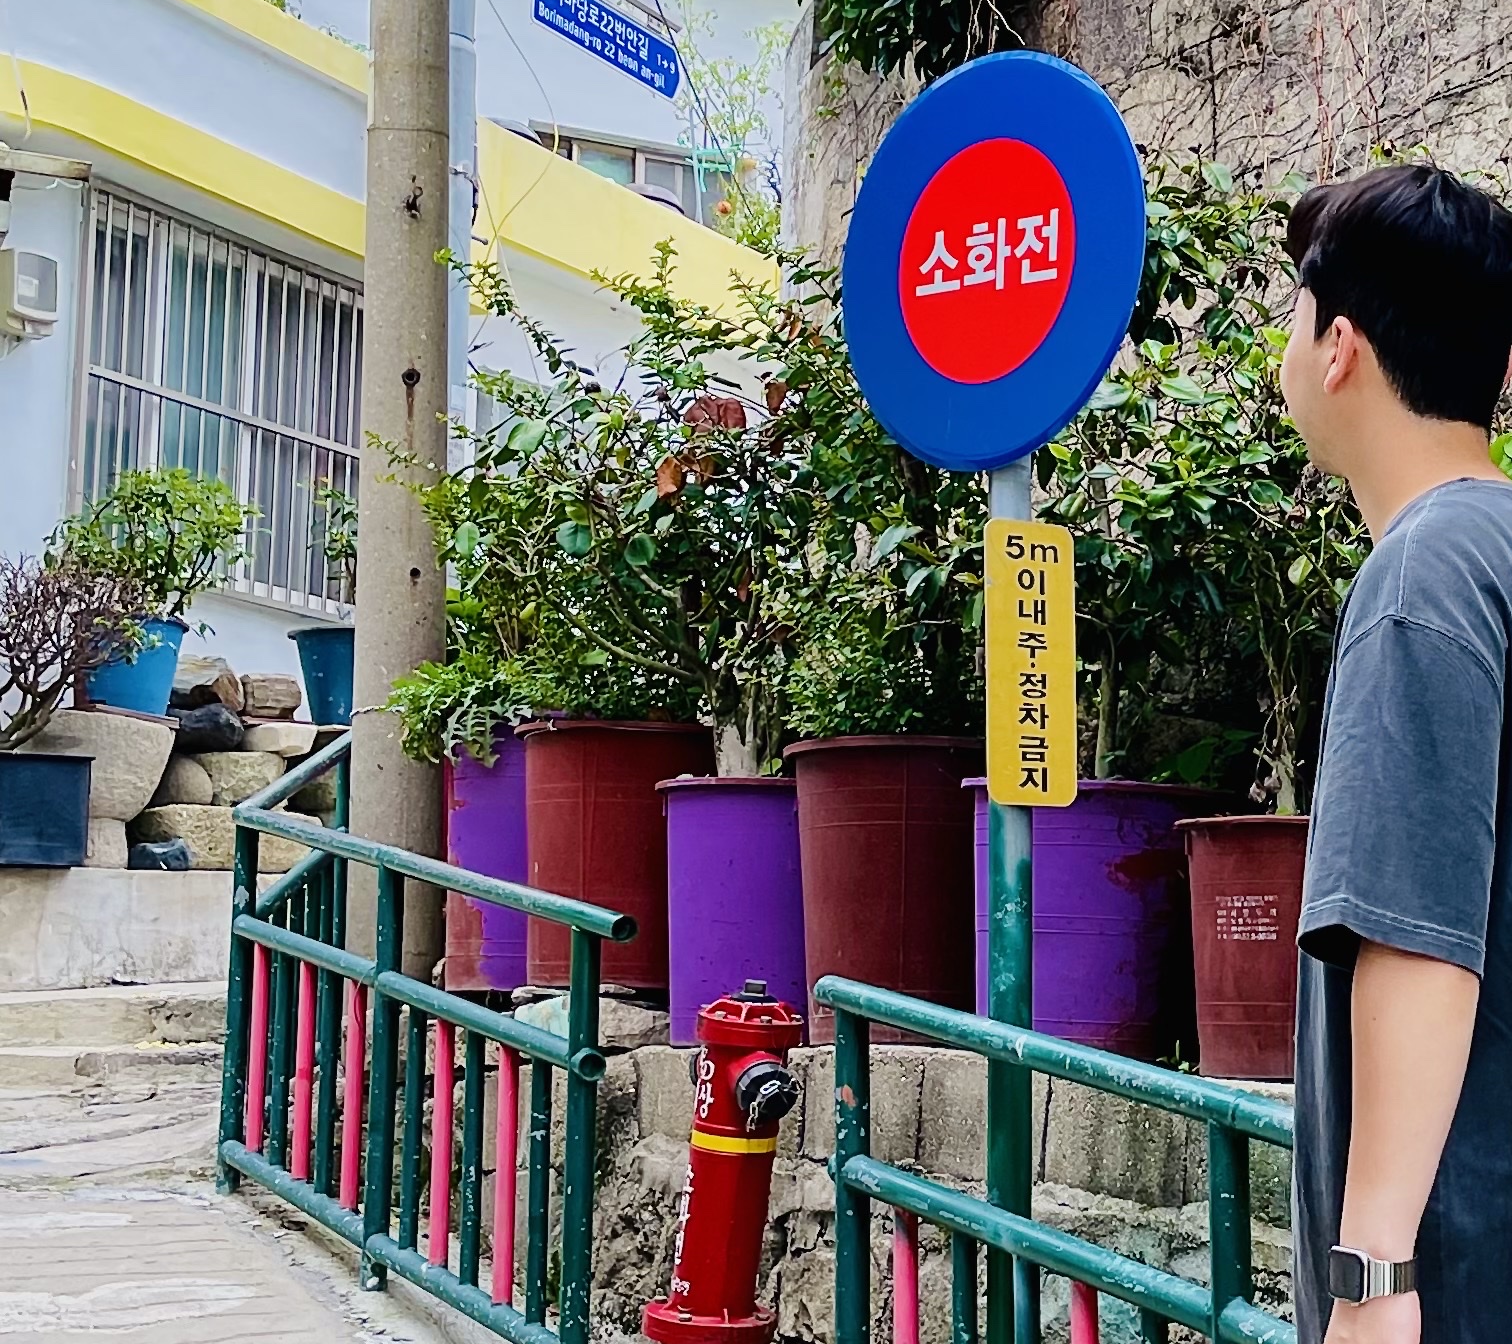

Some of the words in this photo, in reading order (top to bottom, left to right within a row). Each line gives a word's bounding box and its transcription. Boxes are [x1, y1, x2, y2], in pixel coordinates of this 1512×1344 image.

[537, 0, 602, 52] Borimadang-ro
[604, 40, 615, 60] 22
[617, 48, 639, 73] beon
[914, 207, 1061, 298] 소화전
[1004, 534, 1060, 565] 5m
